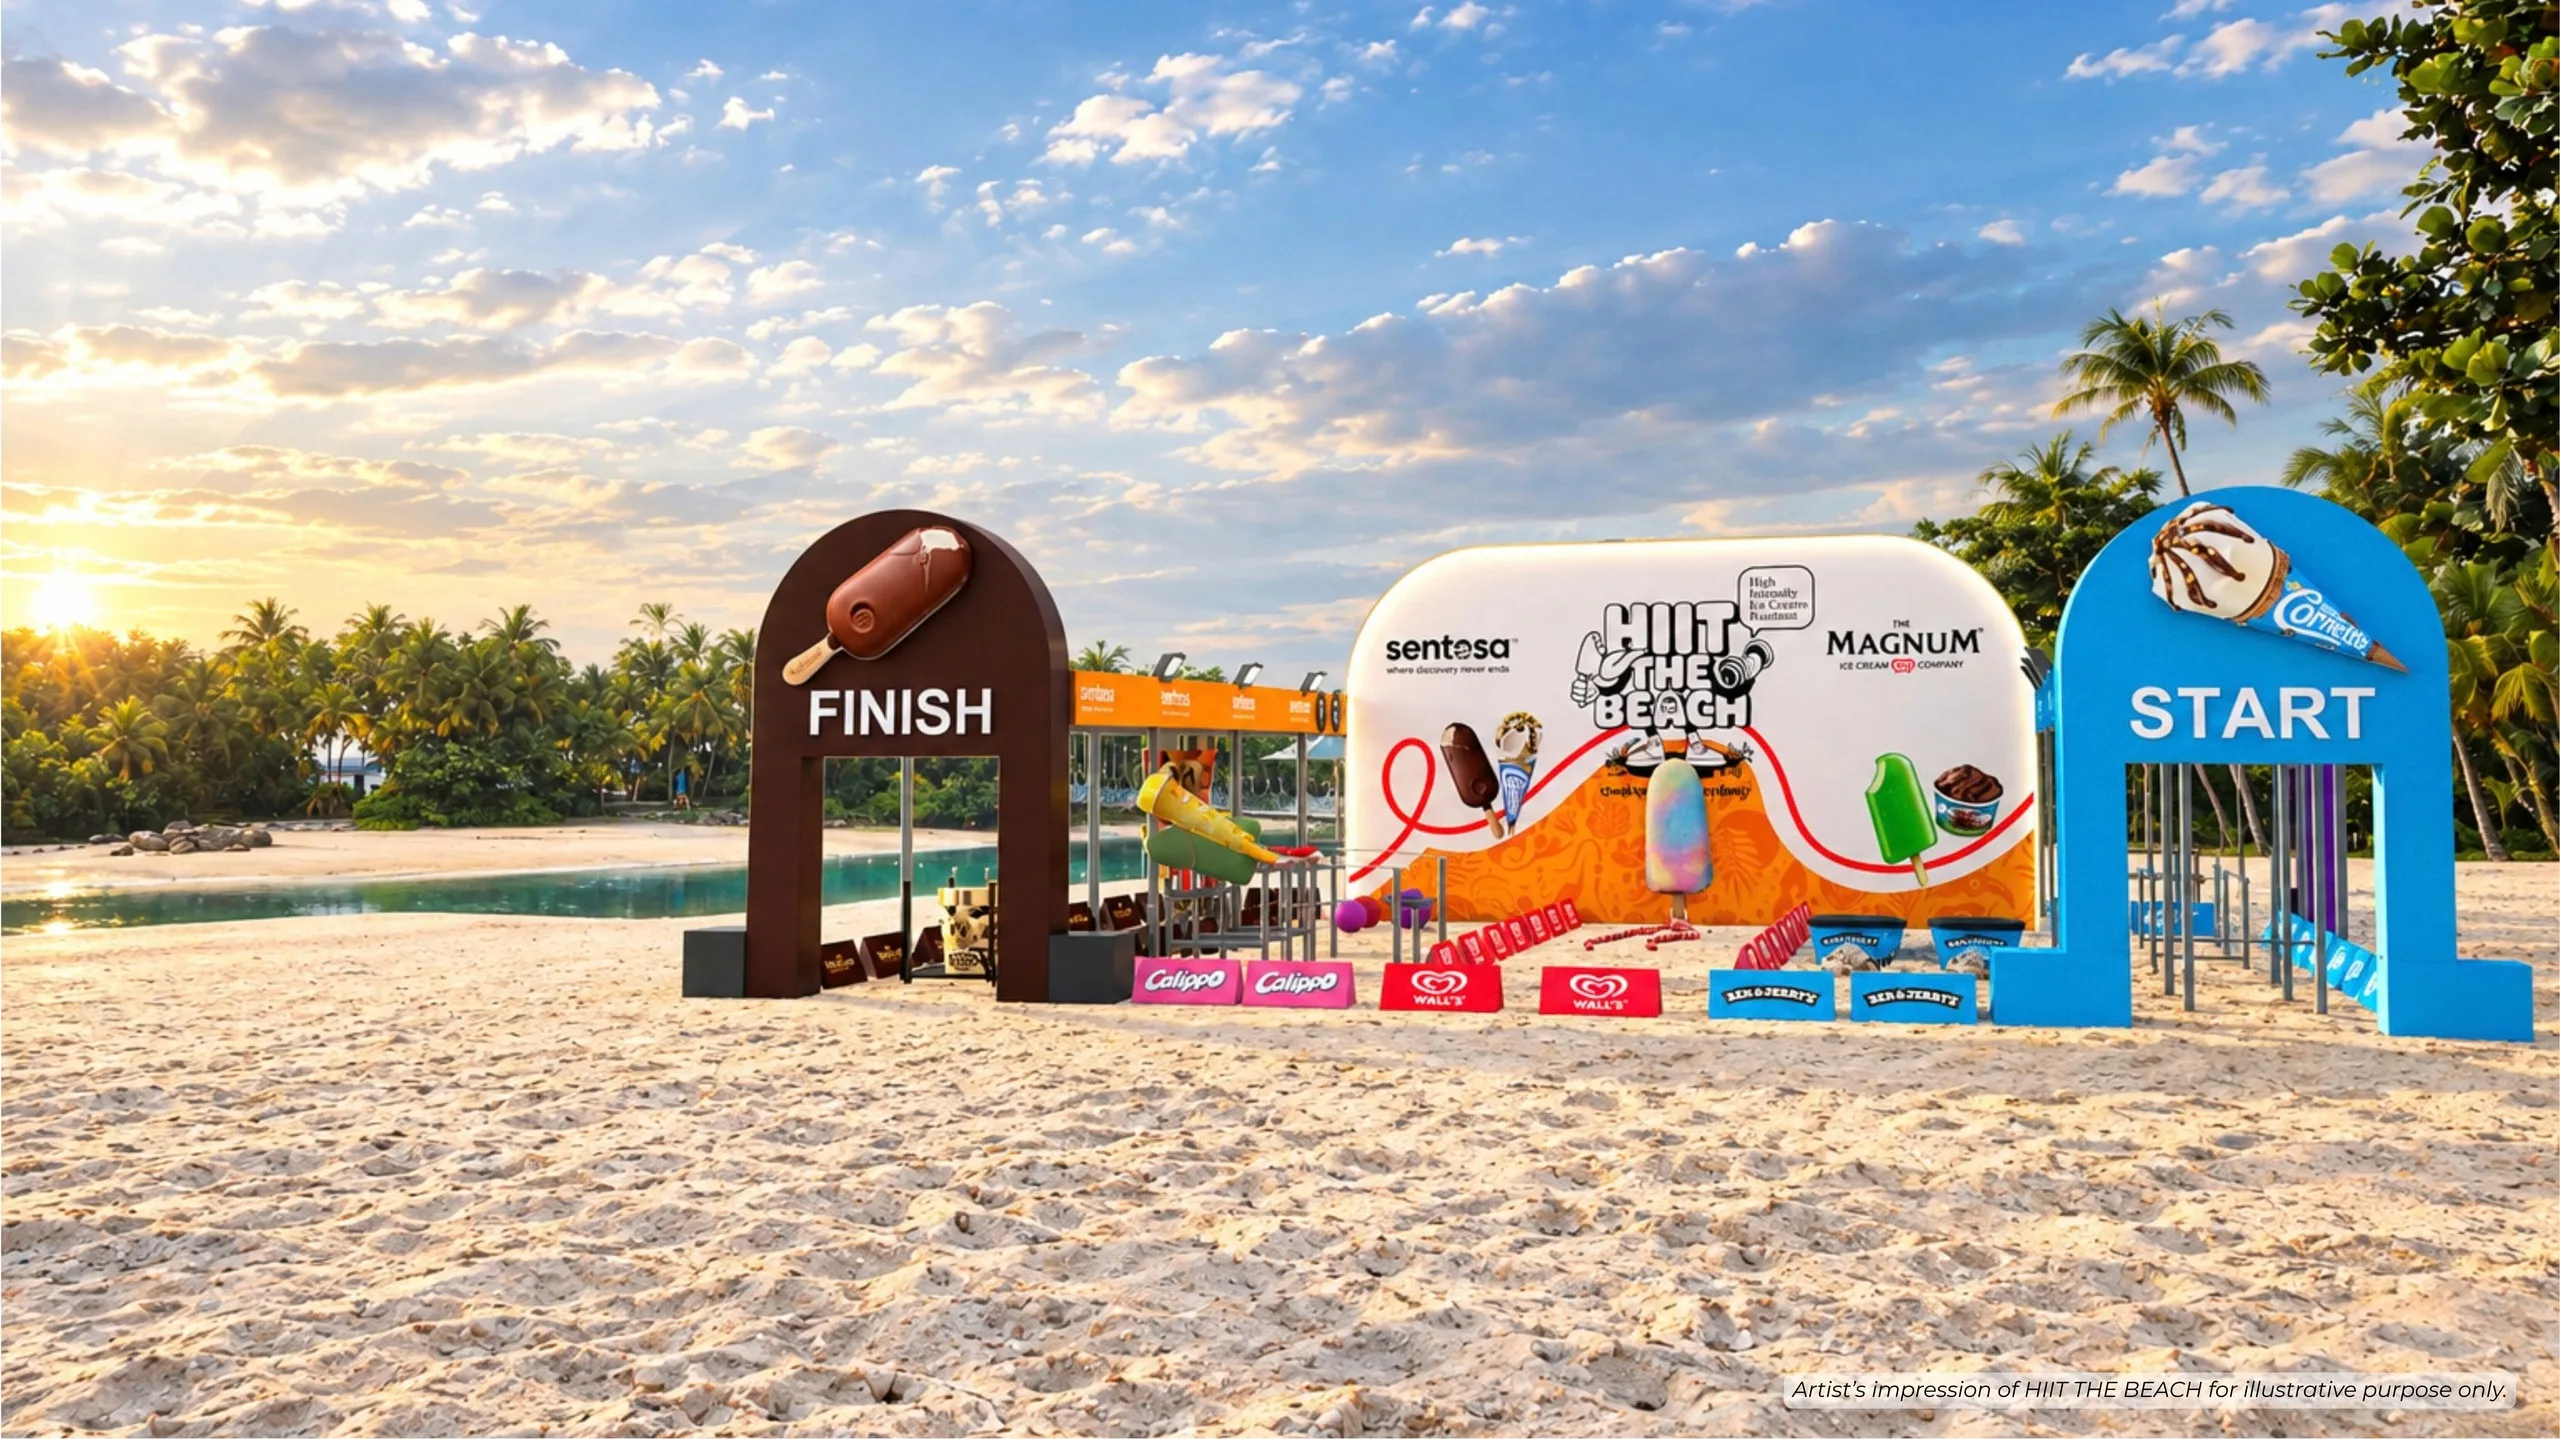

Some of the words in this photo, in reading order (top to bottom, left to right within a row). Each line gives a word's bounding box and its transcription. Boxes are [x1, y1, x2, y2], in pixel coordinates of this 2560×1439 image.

[1604, 601, 1738, 656] HIIT
[1893, 619, 1911, 629] THE
[1386, 634, 1510, 661] sentosa
[1826, 628, 1980, 656] MAGNUM
[1630, 654, 1714, 691] THE
[1917, 660, 1964, 669] COMPANY
[809, 687, 992, 736] FINISH
[1594, 689, 1751, 729] BEACH
[2129, 686, 2376, 739] START
[1144, 969, 1226, 993] Calippo
[1255, 971, 1338, 995] Calippo
